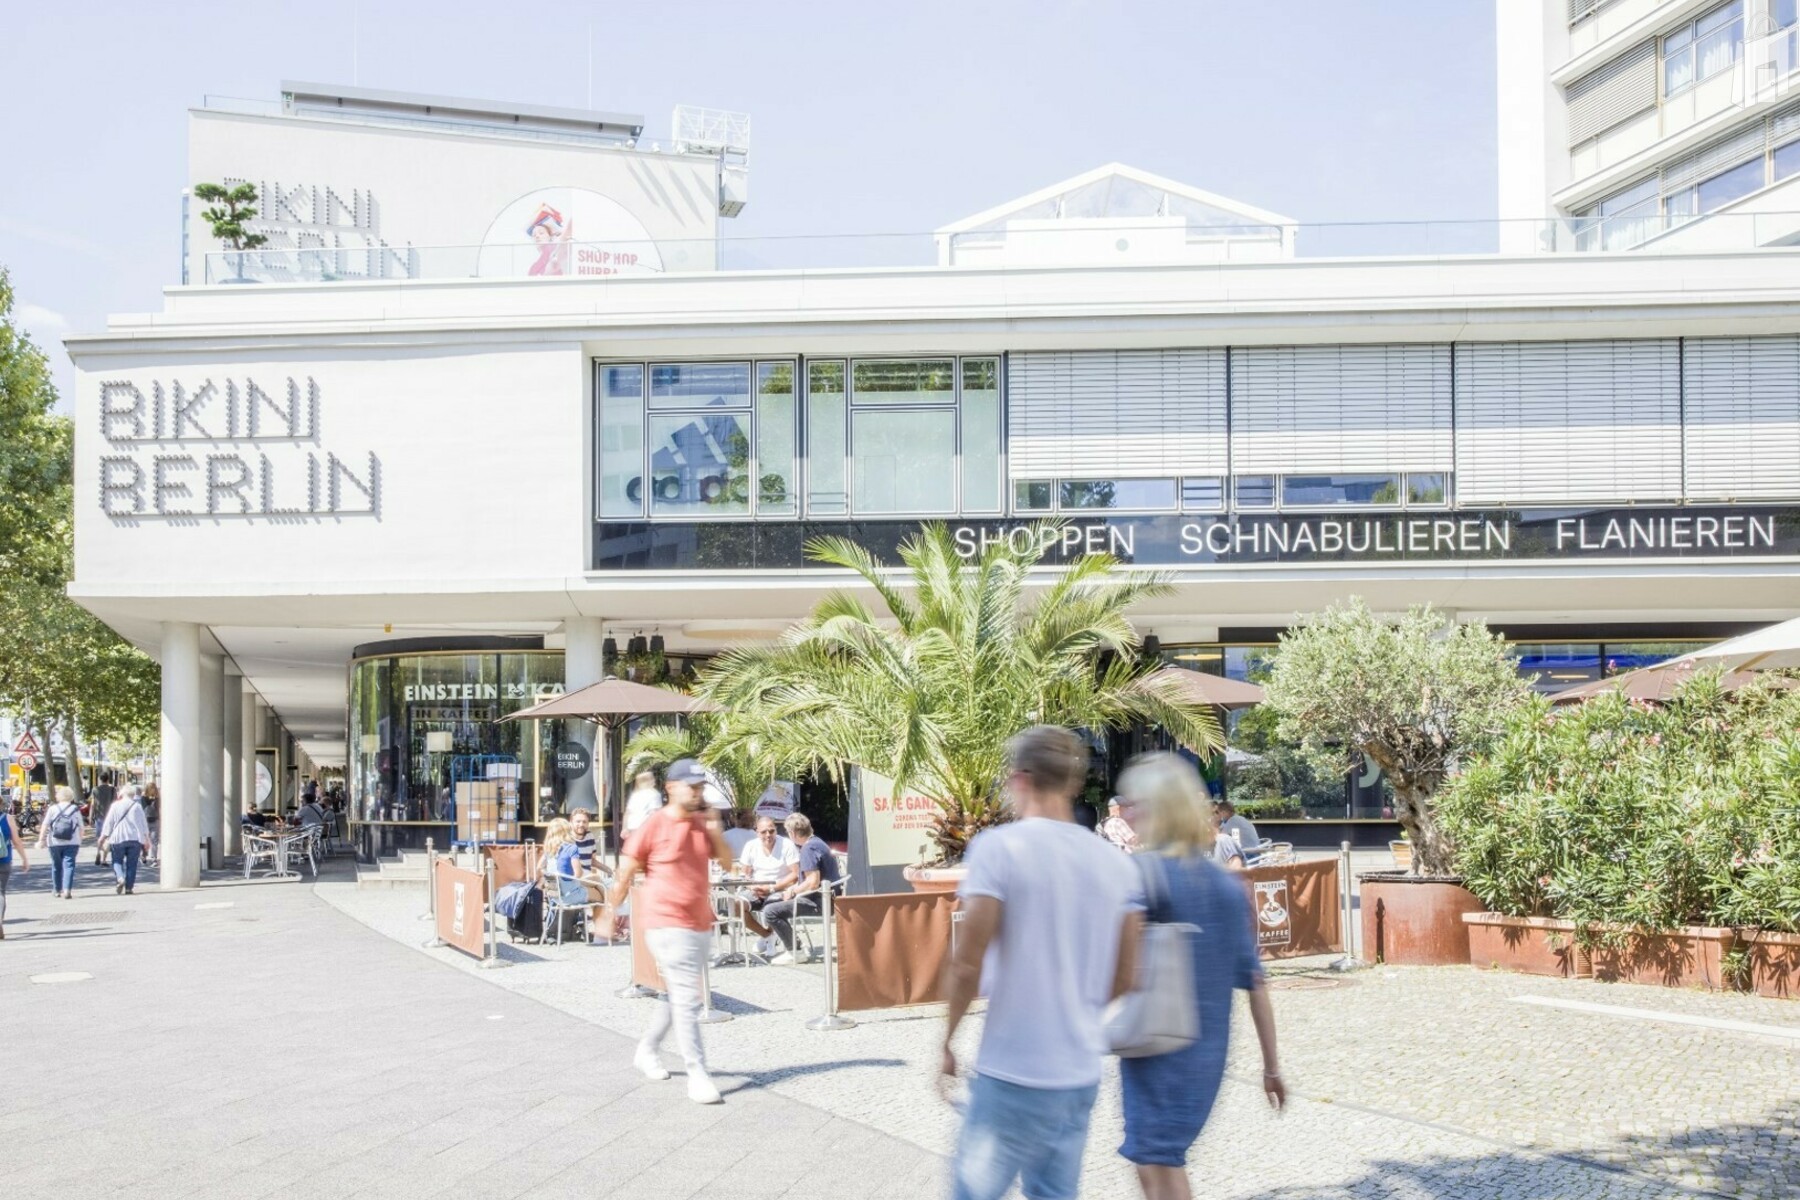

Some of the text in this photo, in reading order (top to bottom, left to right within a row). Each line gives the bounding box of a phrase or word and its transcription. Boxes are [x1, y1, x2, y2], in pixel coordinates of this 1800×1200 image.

[100, 376, 314, 441] BIKINI
[100, 451, 375, 516] BERLIN
[626, 470, 786, 505] addas
[954, 515, 1775, 558] SHOPPEN SCHNABULIEREN FLANIEREN
[404, 683, 498, 701] EINSTEIN
[439, 709, 489, 719] KAFFEE
[21, 757, 32, 766] 30
[557, 753, 580, 761] BIKINI
[557, 761, 585, 769] BERLIN
[1260, 929, 1289, 938] KAFFEE
